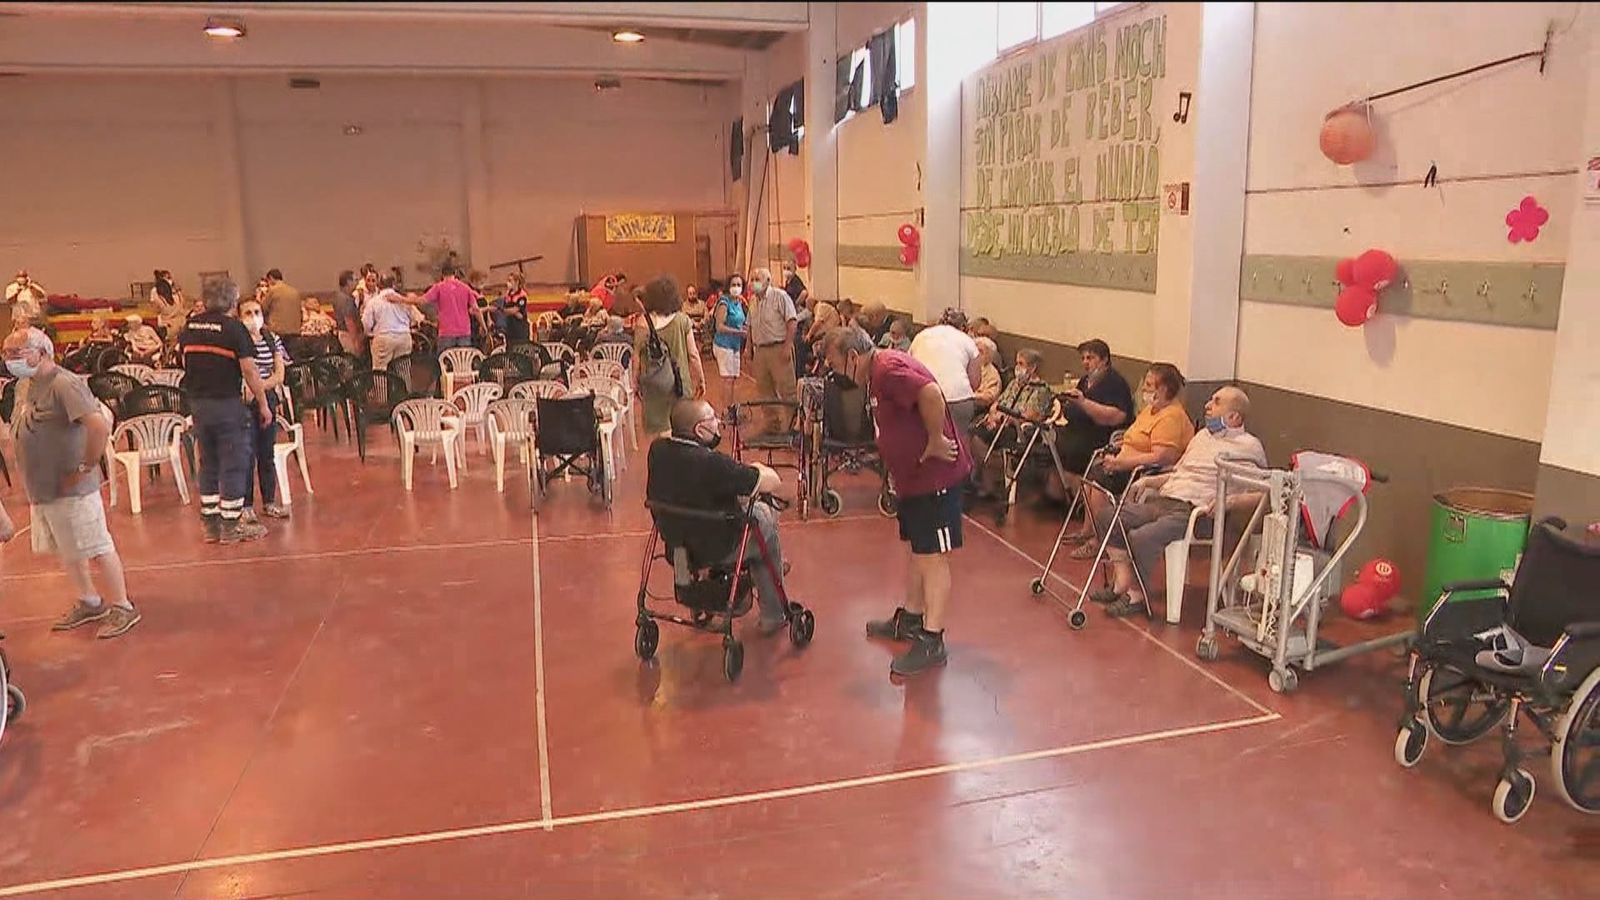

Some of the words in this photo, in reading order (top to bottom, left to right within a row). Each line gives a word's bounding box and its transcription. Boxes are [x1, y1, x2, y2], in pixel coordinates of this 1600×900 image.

[1050, 96, 1073, 149] DE
[1063, 156, 1083, 205] EL
[1092, 206, 1115, 256] DE
